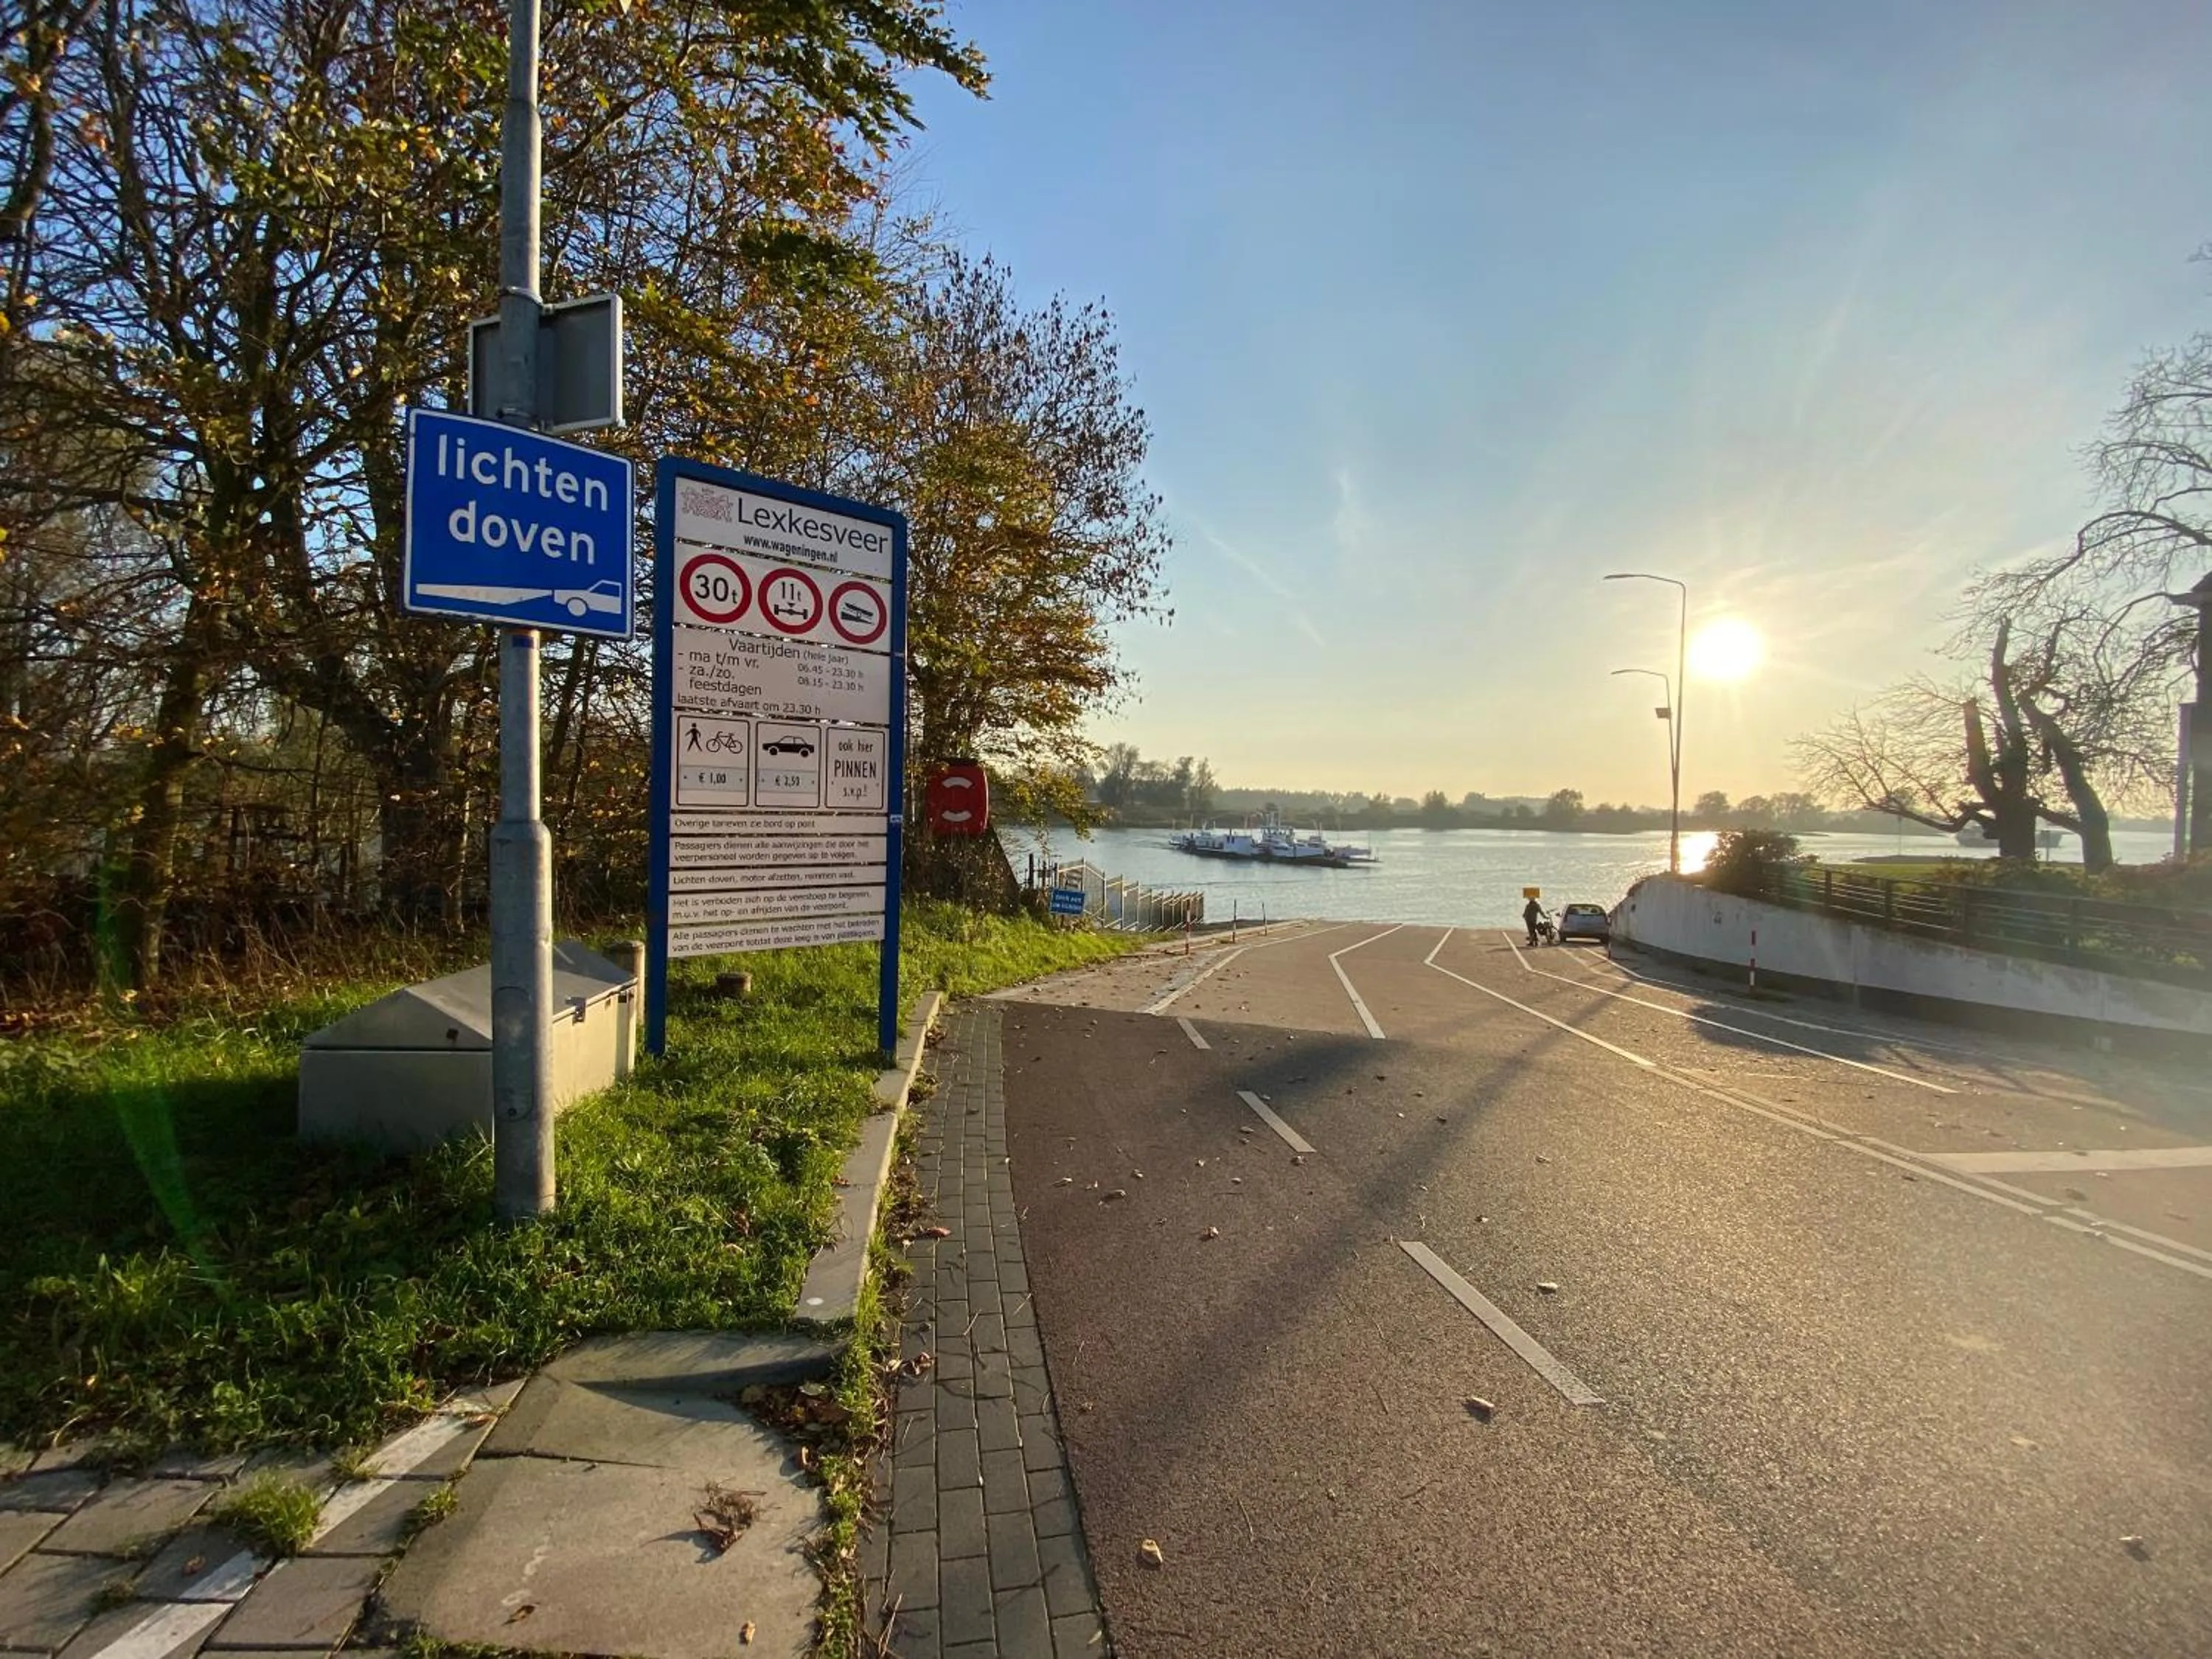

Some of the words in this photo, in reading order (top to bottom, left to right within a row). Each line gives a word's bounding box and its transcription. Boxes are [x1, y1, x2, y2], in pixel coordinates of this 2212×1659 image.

[438, 434, 608, 511] lichten
[448, 500, 594, 564] doven
[738, 498, 888, 553] Lexkesveer
[743, 535, 838, 563] www.wageningen.nl
[729, 638, 800, 659] Vaartijden
[689, 651, 710, 663] ma
[716, 650, 740, 666] t/m
[745, 657, 760, 669] vr.
[689, 664, 735, 679] za./zo.
[832, 667, 856, 678] 23.30
[689, 677, 762, 696] feestdagen
[678, 692, 717, 706] laatste
[720, 697, 759, 710] afvaart
[762, 703, 780, 712] om
[782, 703, 813, 714] 23.30
[815, 706, 821, 715] h
[838, 739, 853, 752] ook
[858, 739, 874, 753] hier
[834, 759, 877, 779] PINNEN
[710, 772, 726, 785] 1,00
[674, 818, 710, 829] Overige
[763, 819, 782, 827] bord
[785, 821, 796, 829] op
[798, 820, 815, 829] pont
[675, 841, 721, 851] Passagiers
[838, 839, 856, 847] door
[674, 852, 737, 862] veerpersoneel
[739, 852, 771, 861] worden
[772, 852, 807, 861] gegeven
[830, 851, 858, 860] volgen.
[673, 876, 706, 885] Lichten
[708, 875, 738, 884] doven,
[740, 874, 767, 883] motor
[804, 872, 837, 880] remmen
[673, 899, 689, 907] Het
[701, 896, 743, 905] verboden
[763, 895, 775, 905] op
[776, 894, 787, 902] de
[789, 892, 827, 902] veerstoep
[702, 908, 719, 917] het
[751, 905, 782, 915] afrijden
[784, 904, 799, 913] van
[672, 931, 689, 940] Alle
[692, 928, 738, 940] passagiers
[740, 926, 769, 936] dienen
[782, 922, 815, 933] wachten
[816, 922, 832, 930] met
[691, 943, 703, 951] de
[706, 939, 745, 949] veerpont
[746, 937, 771, 946] totdat
[773, 936, 793, 944] deze
[821, 931, 835, 940] van
